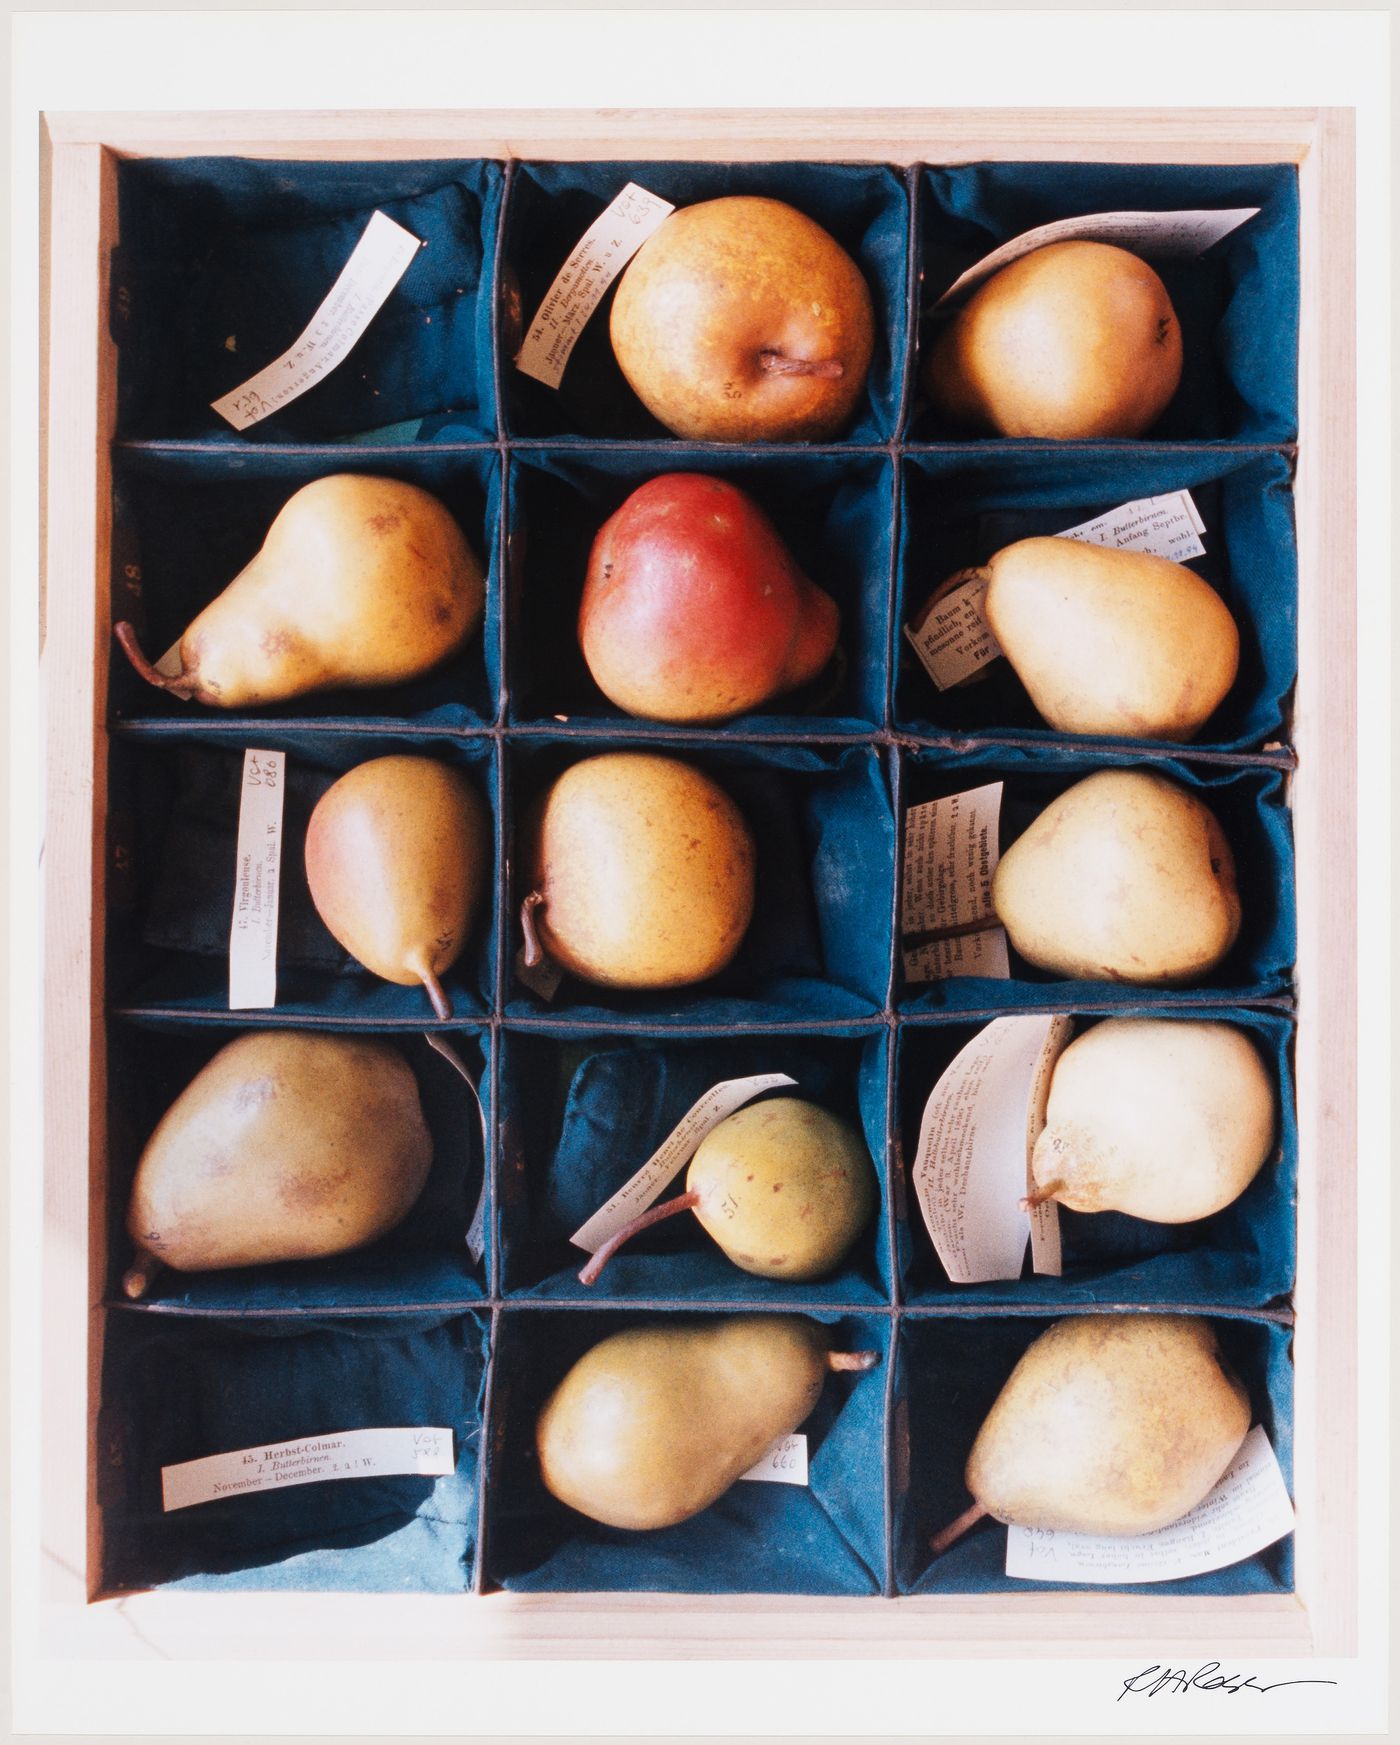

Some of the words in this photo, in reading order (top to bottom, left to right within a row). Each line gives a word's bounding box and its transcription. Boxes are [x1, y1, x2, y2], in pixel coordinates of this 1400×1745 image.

[541, 290, 562, 321] Olivier
[560, 271, 572, 284] de
[935, 606, 961, 624] Baum
[242, 1455, 258, 1465] 45.
[264, 1442, 340, 1461] Herbst-Colmar.
